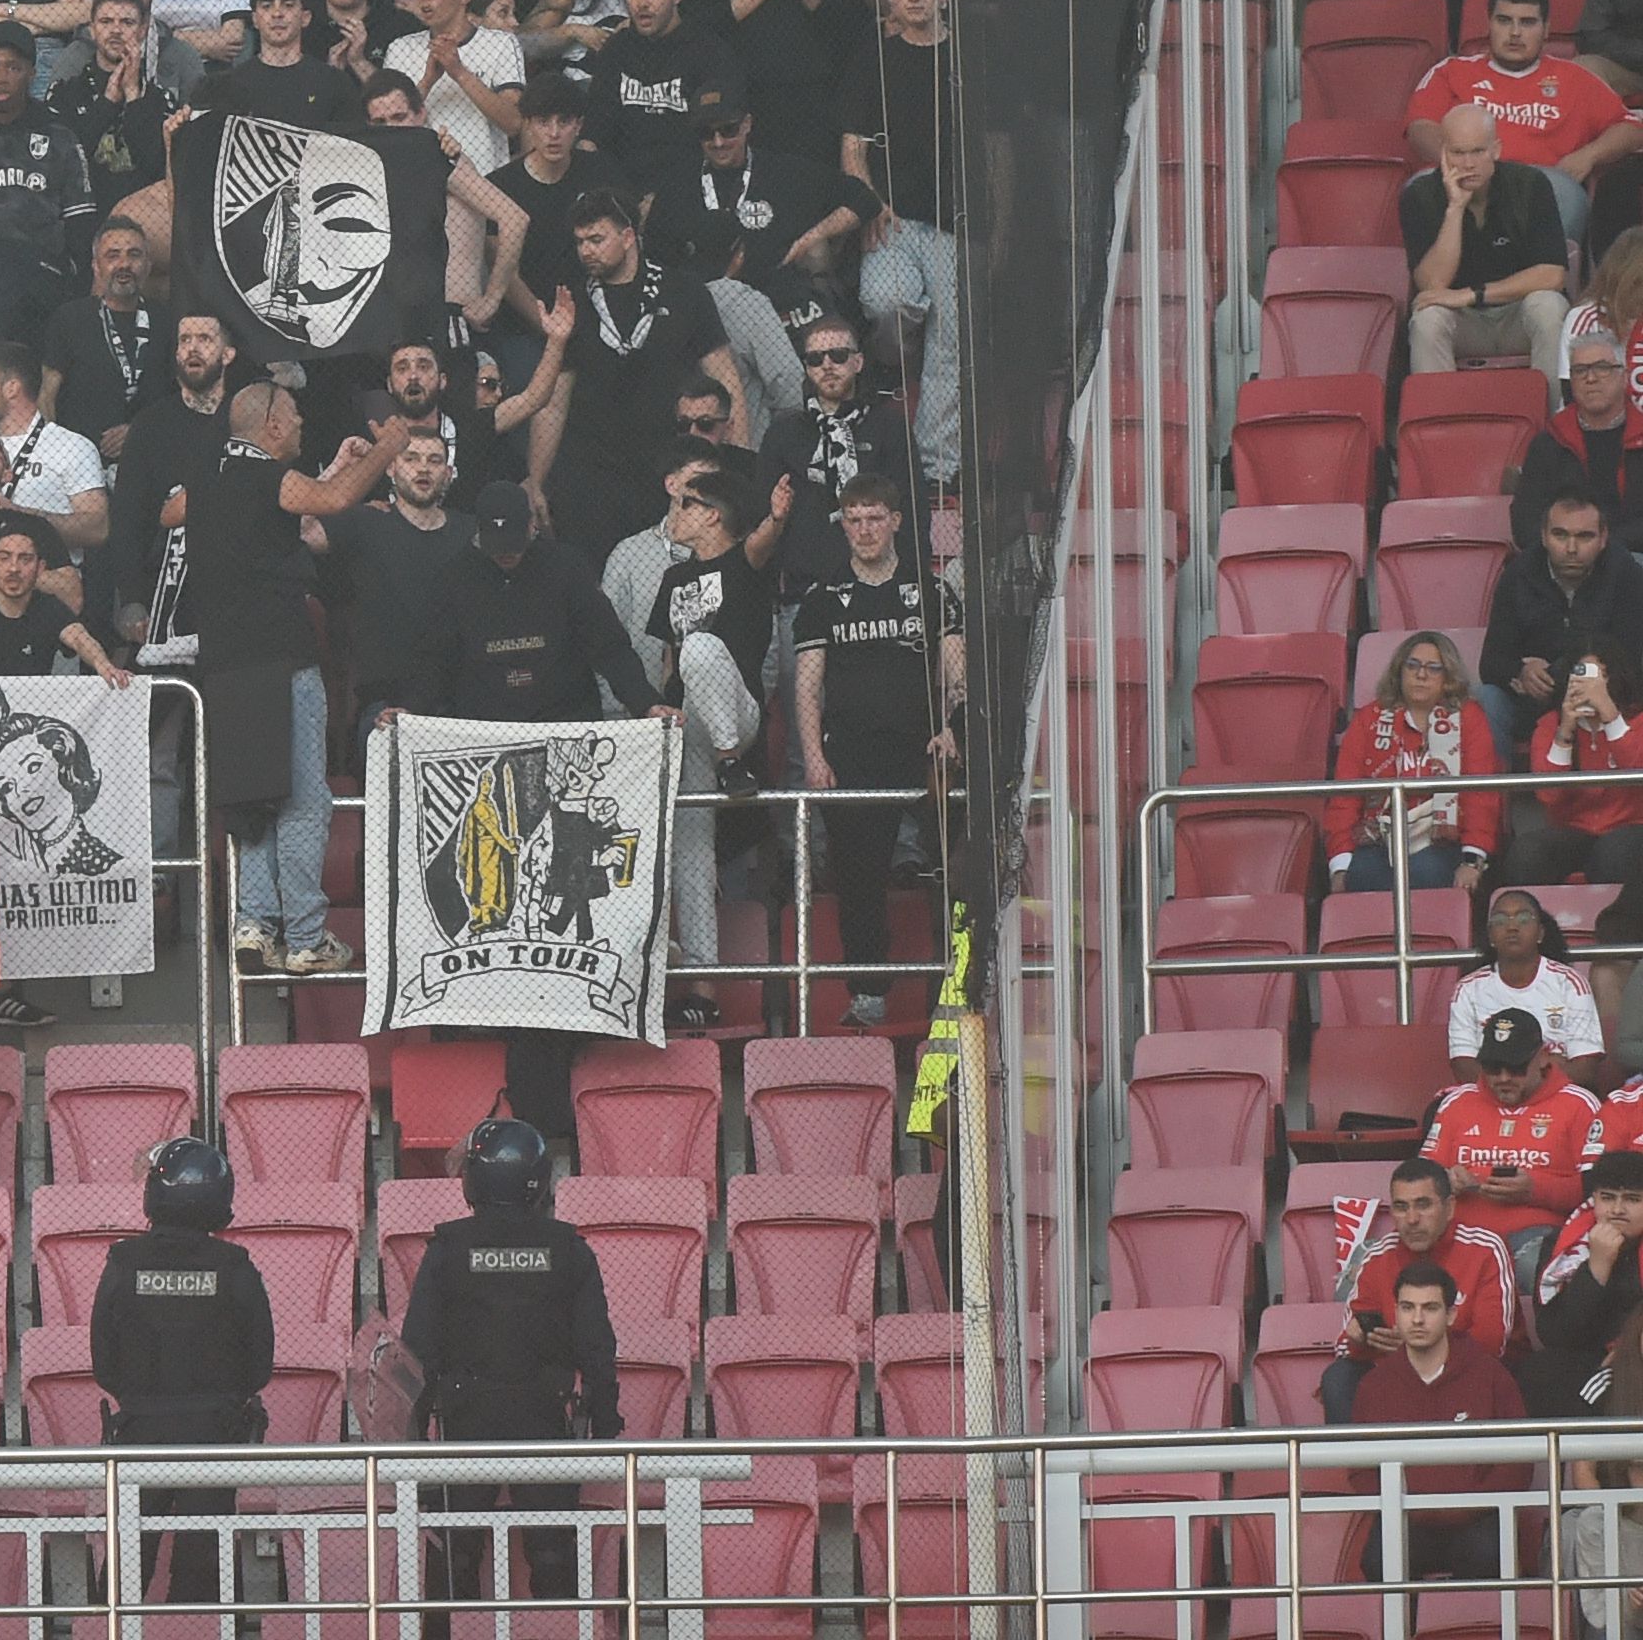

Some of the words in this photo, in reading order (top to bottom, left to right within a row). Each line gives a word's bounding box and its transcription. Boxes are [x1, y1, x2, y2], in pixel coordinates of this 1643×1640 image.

[441, 946, 494, 976] ON
[508, 944, 601, 976] TOUR
[1458, 1145, 1551, 1168] Emirates
